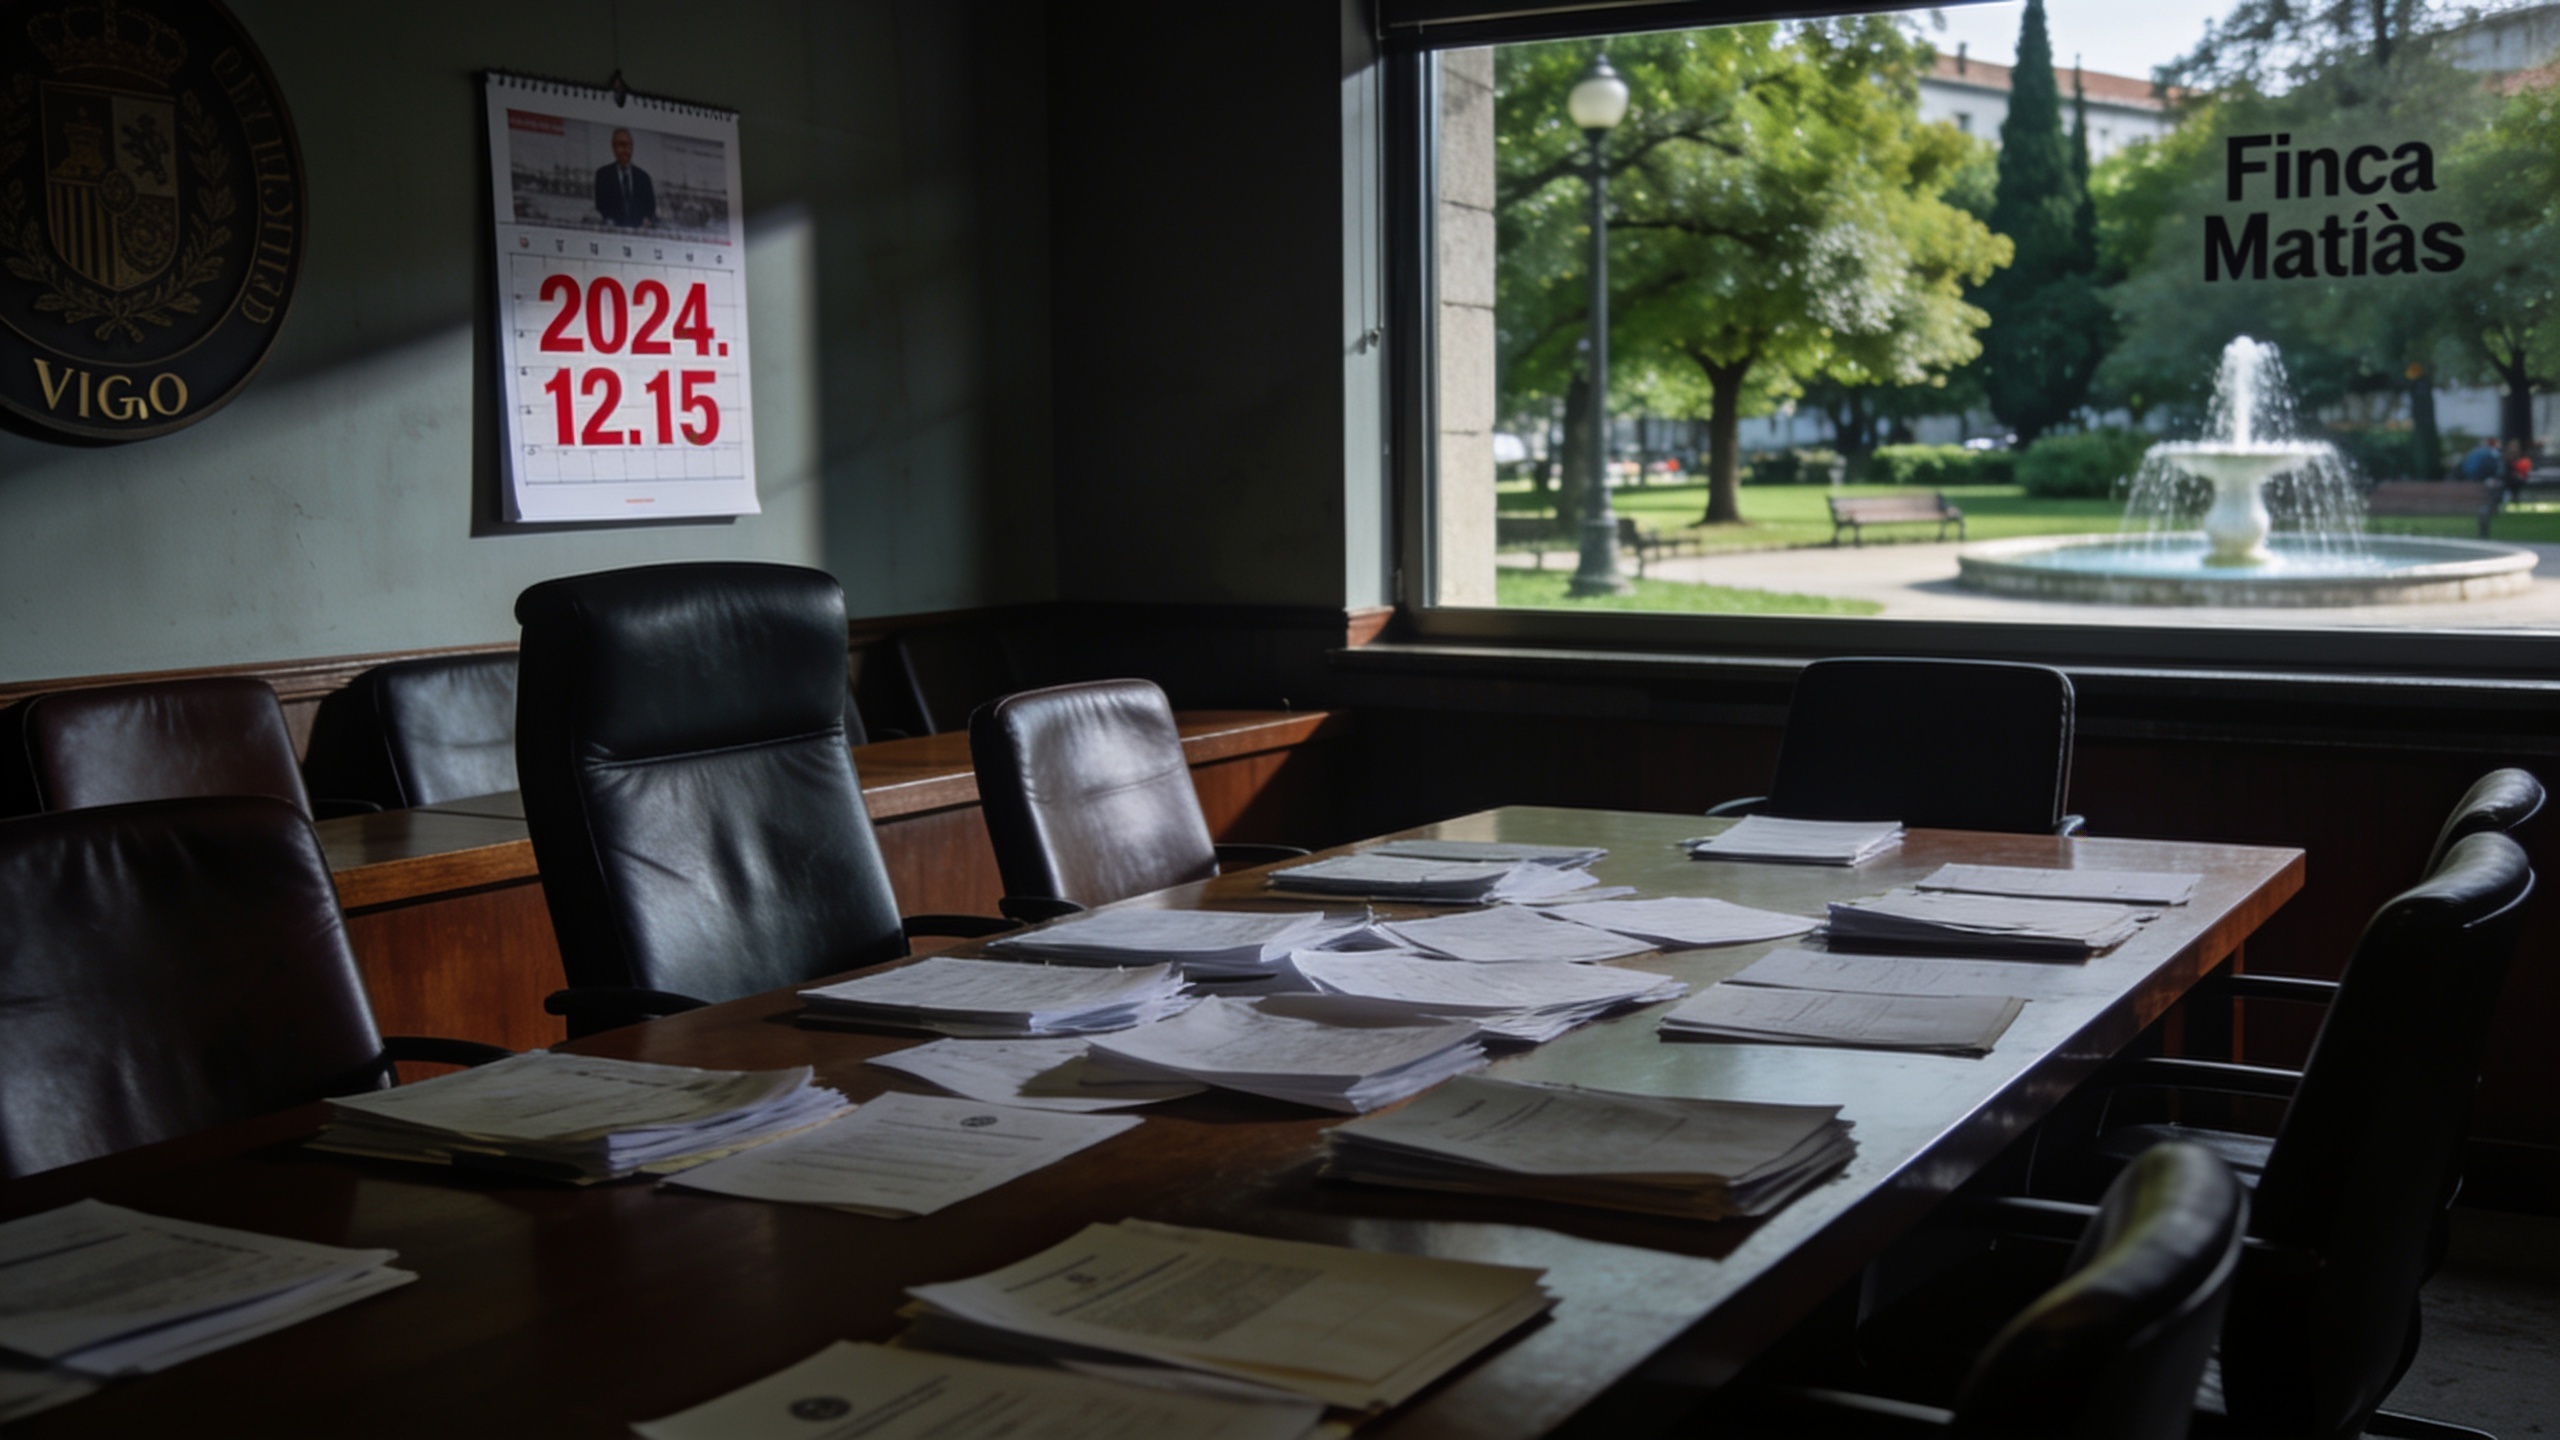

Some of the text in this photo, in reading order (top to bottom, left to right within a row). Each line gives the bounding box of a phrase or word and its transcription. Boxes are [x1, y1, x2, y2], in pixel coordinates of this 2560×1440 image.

[2227, 133, 2437, 201] Finca
[2204, 203, 2466, 281] Matíàs
[540, 274, 728, 356] 2024.
[545, 367, 720, 446] 12.15
